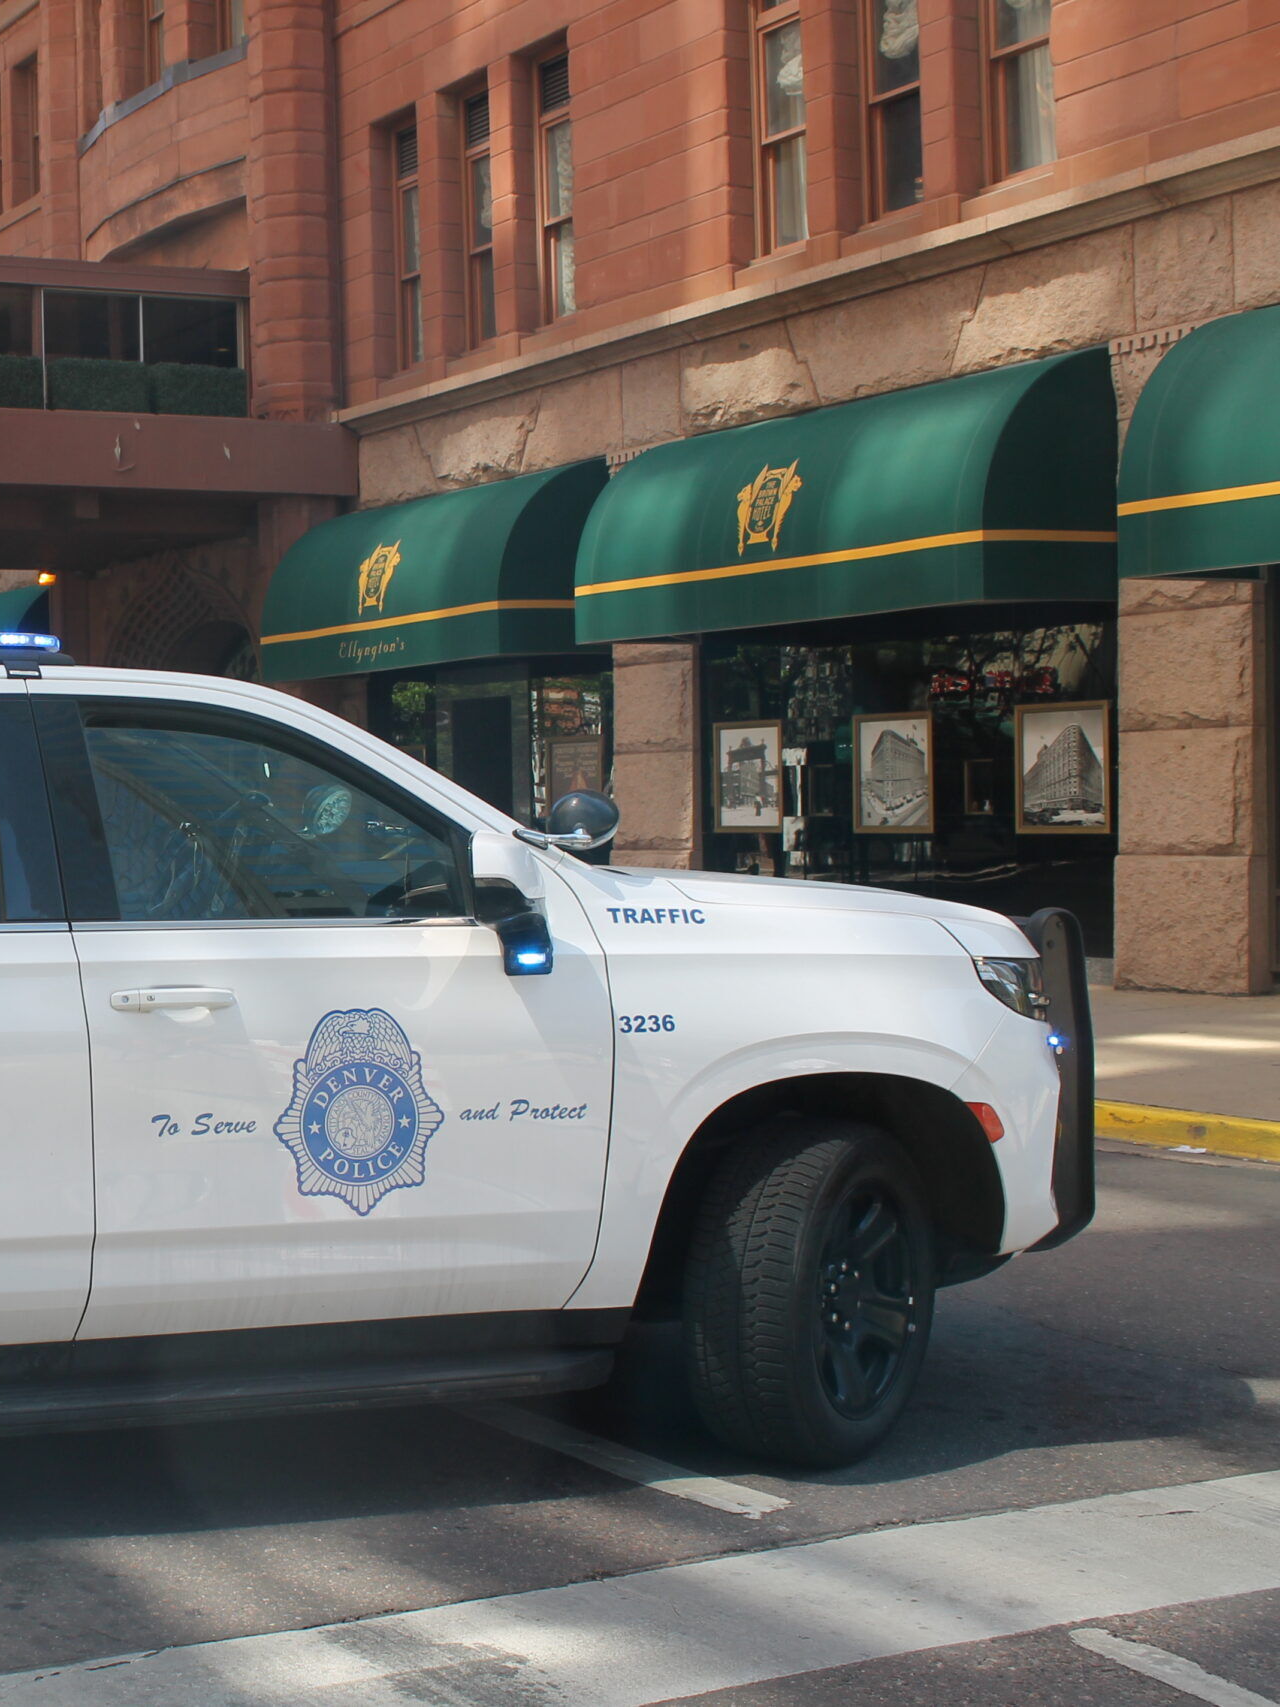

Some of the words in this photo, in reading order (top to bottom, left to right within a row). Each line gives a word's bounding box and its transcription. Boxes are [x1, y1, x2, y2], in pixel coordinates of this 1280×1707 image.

[756, 497, 774, 506] PALACE
[752, 506, 772, 520] HOTEL
[338, 637, 407, 664] Ellyngton's
[606, 908, 706, 924] TRAFFIC
[618, 1014, 676, 1034] 3236
[313, 1067, 404, 1109] DENVER
[459, 1102, 500, 1121] and
[509, 1099, 588, 1121] Protect
[151, 1114, 180, 1137] To
[191, 1112, 257, 1136] Serve
[319, 1141, 404, 1179] POLICE
